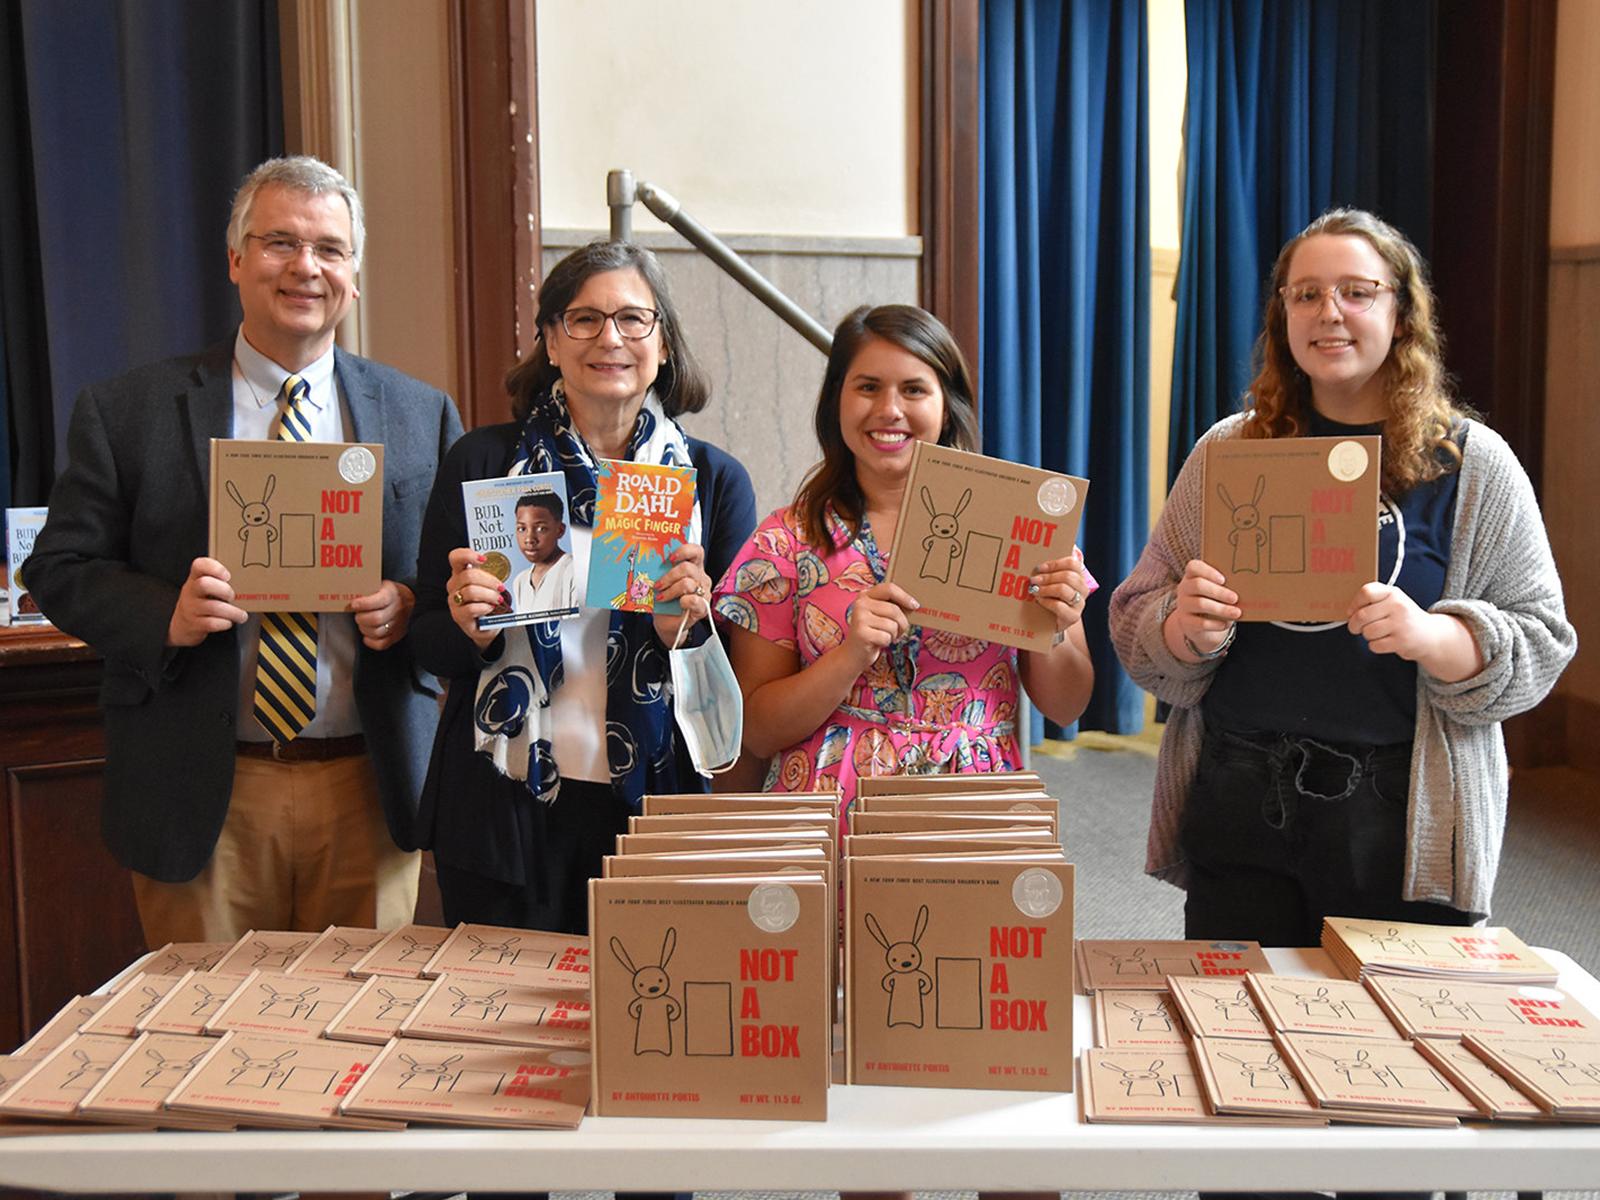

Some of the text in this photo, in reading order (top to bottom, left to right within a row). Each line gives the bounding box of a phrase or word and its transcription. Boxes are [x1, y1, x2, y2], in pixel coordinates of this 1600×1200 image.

[616, 472, 682, 496] ROALD
[321, 490, 364, 514] NOT
[614, 491, 679, 518] DAHL
[320, 517, 336, 541] A
[605, 517, 681, 535] MAGIC FINGER
[1011, 515, 1058, 548] NOT
[19, 540, 32, 551] No
[472, 534, 515, 551] BUDDY
[320, 544, 364, 569] BOX
[1004, 544, 1021, 570] A
[998, 571, 1036, 603] BO
[990, 926, 1047, 958] NOT
[556, 963, 590, 973] BO
[740, 949, 798, 982] NOT
[1197, 952, 1242, 960] NOT
[1201, 960, 1216, 968] A
[989, 963, 1009, 994] A
[1204, 967, 1249, 976] BOX
[740, 986, 761, 1019] A
[1508, 998, 1561, 1009] NOT
[1520, 1007, 1540, 1016] A
[990, 999, 1048, 1031] BOX
[1527, 1016, 1586, 1029] BOX
[740, 1024, 801, 1058] BOX
[511, 1075, 529, 1085] A
[515, 1064, 573, 1078] NOT
